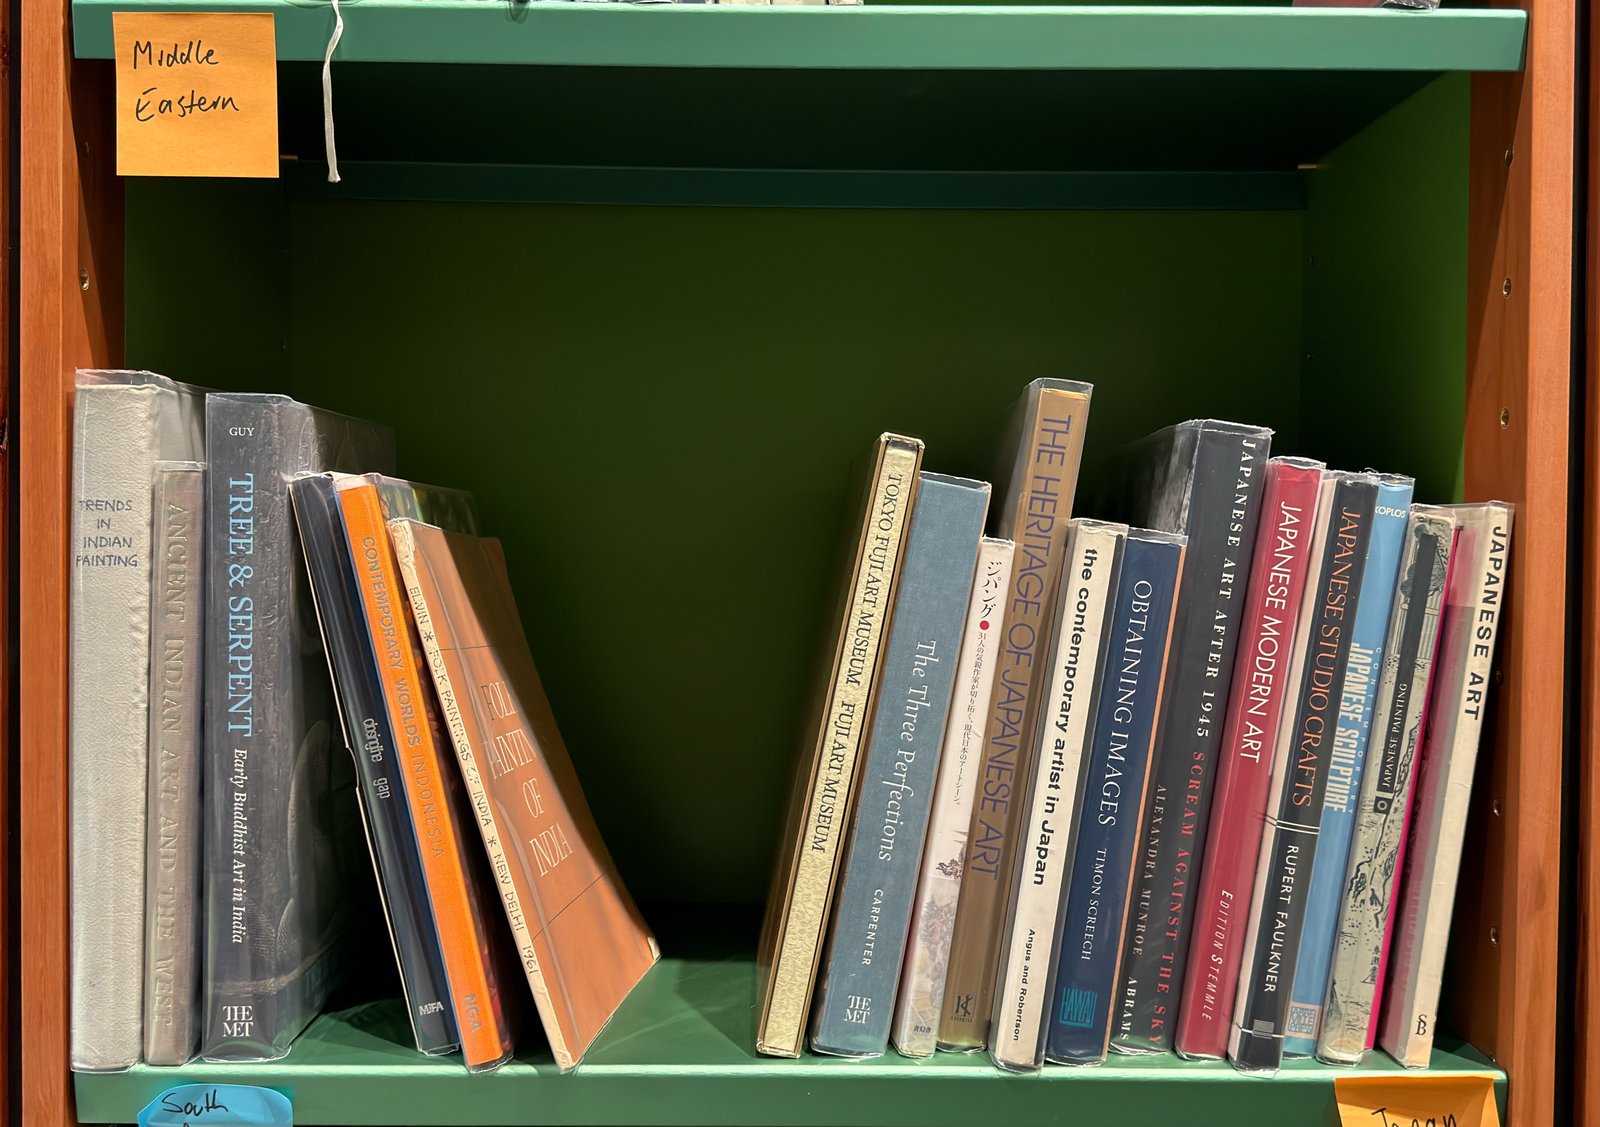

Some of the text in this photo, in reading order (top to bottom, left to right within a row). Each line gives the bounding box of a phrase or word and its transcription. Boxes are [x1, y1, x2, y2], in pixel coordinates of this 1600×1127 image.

[133, 40, 219, 69] Middle
[136, 88, 239, 121] Eastern
[229, 427, 255, 437] GUY
[76, 554, 138, 567] PAINTING
[80, 499, 133, 512] TRENDS
[83, 537, 133, 549] INDIAN
[97, 518, 111, 530] IN
[228, 472, 254, 737] TREE & SERPENT
[981, 561, 1002, 619] ジパング
[1239, 501, 1302, 764] JAPANESE MODERN ART
[1464, 526, 1506, 722] JAPANESE ART
[362, 536, 449, 858] CONTEMPORARY WORLDS INDONESIA
[811, 474, 903, 853] TOKYO FUJI ART MUSEUM FUJI ART MUSEUM
[971, 415, 1072, 880] THE HERITAGE OF JAPANESE ART
[1098, 580, 1153, 827] OBTAINING IMAGES
[1292, 506, 1361, 807] JAPANESE STUDIO CRAFTS
[155, 502, 187, 1026] ANCIENT INDIAN ART AND THE WEST
[878, 640, 939, 862] The Three Perfections
[1033, 548, 1098, 886] the contemporary artist in Japan
[1148, 439, 1256, 1042] JAPANESE ART AFTER 1945 SCREAM AGAINST THE SKY
[1324, 642, 1374, 813] JAPANESE SCULPTURE
[1347, 647, 1382, 814] CONTEMPORARY
[1382, 683, 1408, 787] JAPANESE PAINTING
[373, 777, 391, 799] gap
[522, 777, 545, 820] OF
[230, 748, 247, 944] Early Buddhist Art in India
[472, 791, 492, 827] INDIA
[494, 853, 511, 885] NEW
[504, 892, 525, 931] DELHI
[522, 945, 540, 975] 1961
[529, 823, 574, 878] INDIA
[1132, 784, 1168, 955] ALEXANDRA MUNROE
[861, 888, 884, 965] CARPENTER
[1081, 848, 1107, 960] TIMON SCREECH
[1201, 889, 1234, 1021] EDITION STEMMLE
[1263, 844, 1299, 992] RUPERT FAULKNER
[222, 1005, 253, 1022] THE
[222, 1022, 254, 1038] MET
[463, 993, 482, 1033] NGA
[844, 1009, 870, 1024] MET
[848, 995, 871, 1011] THE
[1013, 929, 1036, 1041] Angus and Robertson
[1120, 976, 1138, 1040] ABRAMS
[161, 1088, 229, 1117] South
